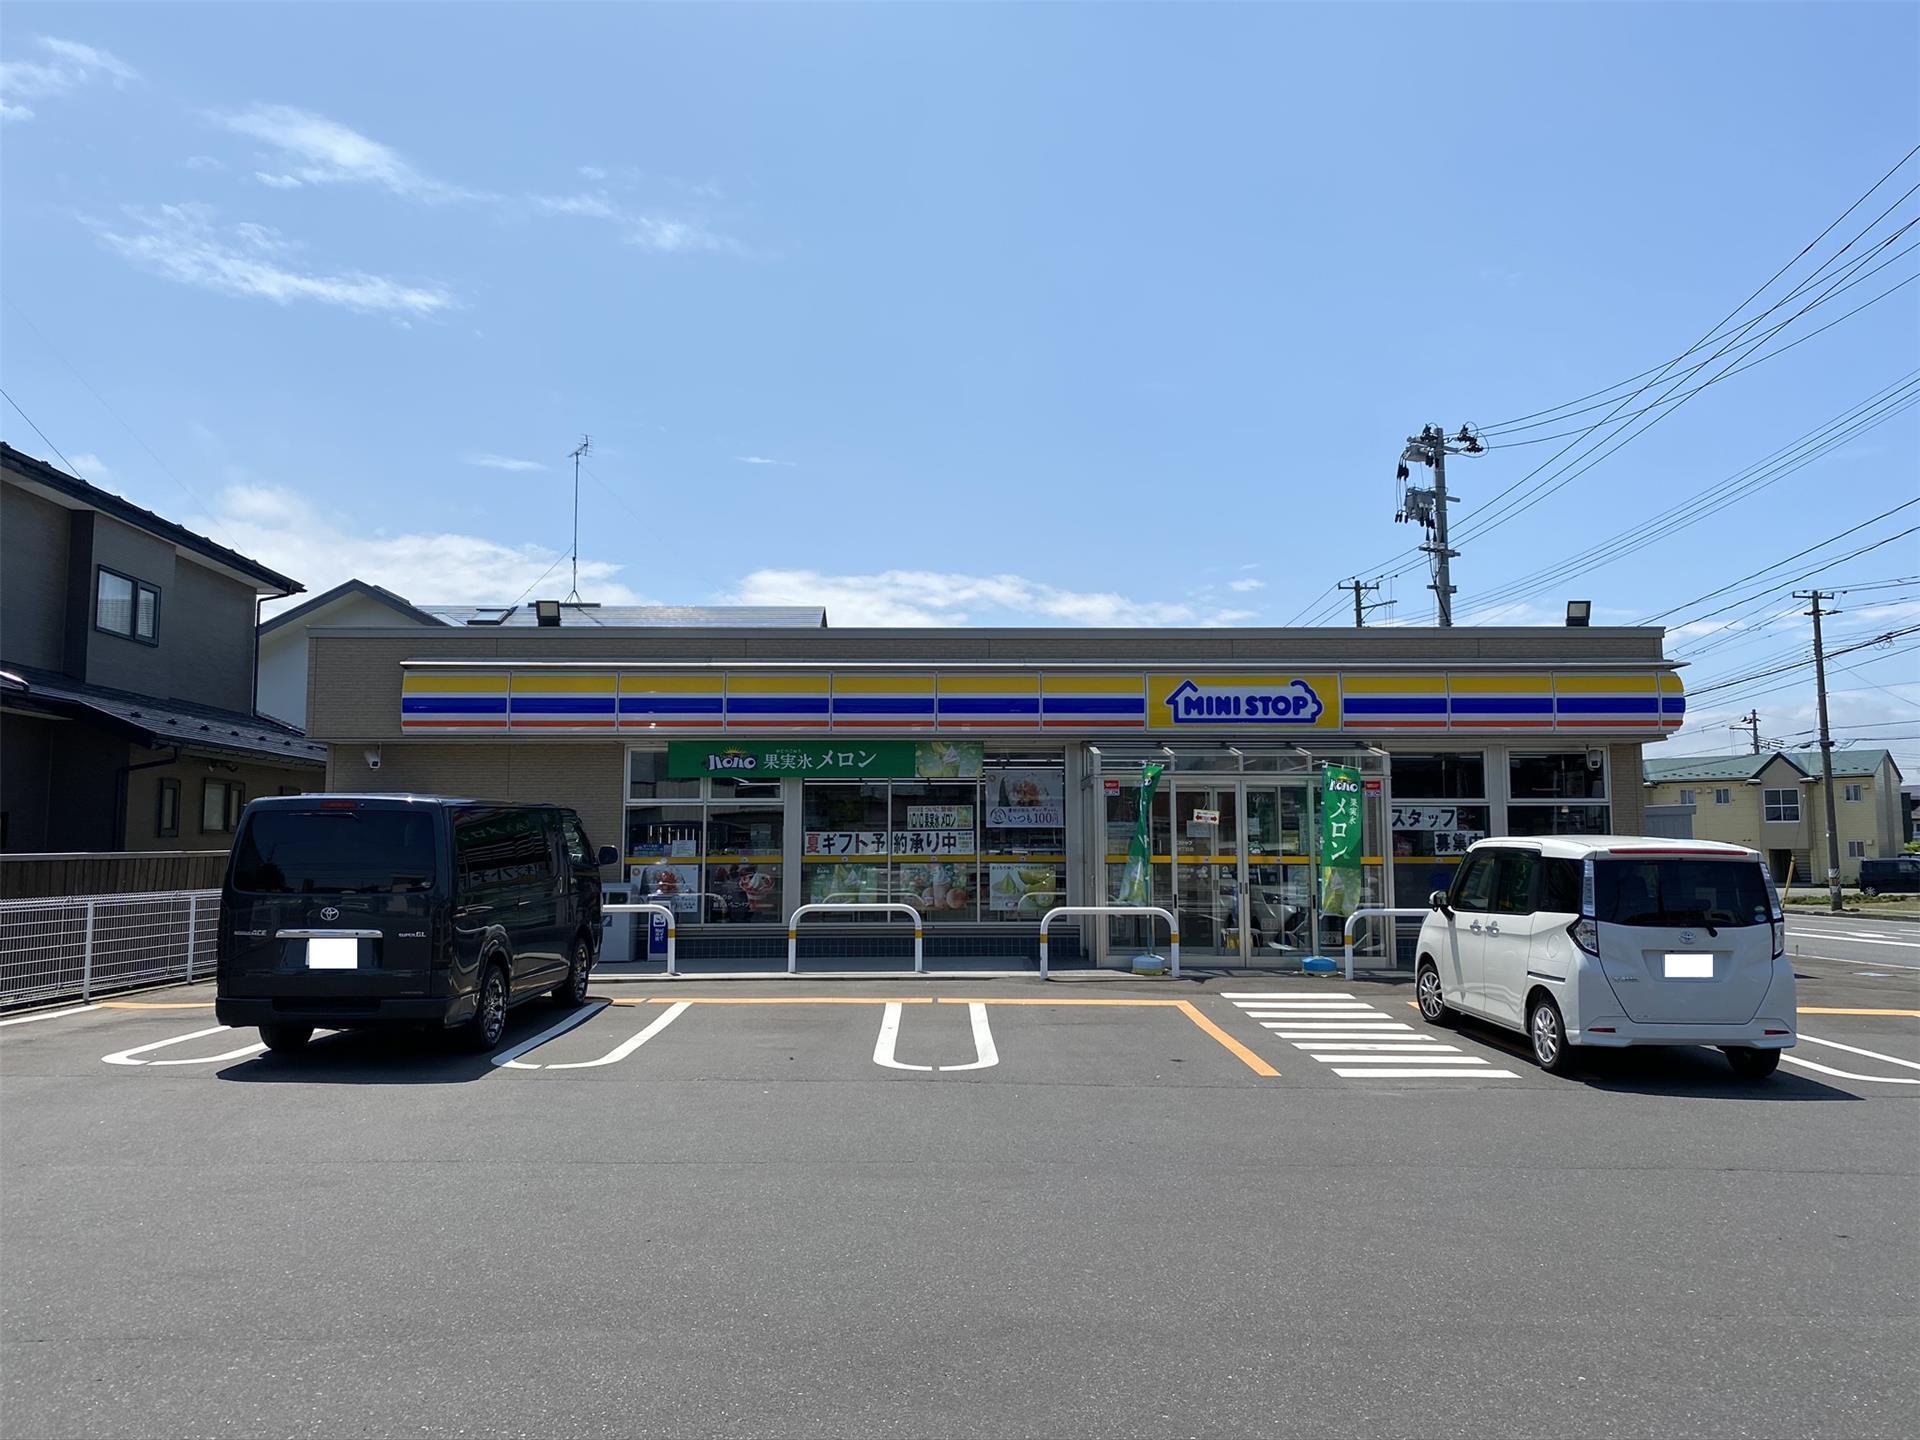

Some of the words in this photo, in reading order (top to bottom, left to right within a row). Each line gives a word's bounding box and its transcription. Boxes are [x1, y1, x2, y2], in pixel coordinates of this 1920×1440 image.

[1183, 695, 1241, 716] MINI
[1245, 695, 1309, 716] STOP
[815, 750, 878, 770] メロン
[1391, 808, 1456, 828] スタッフ
[1330, 797, 1348, 860] メロン
